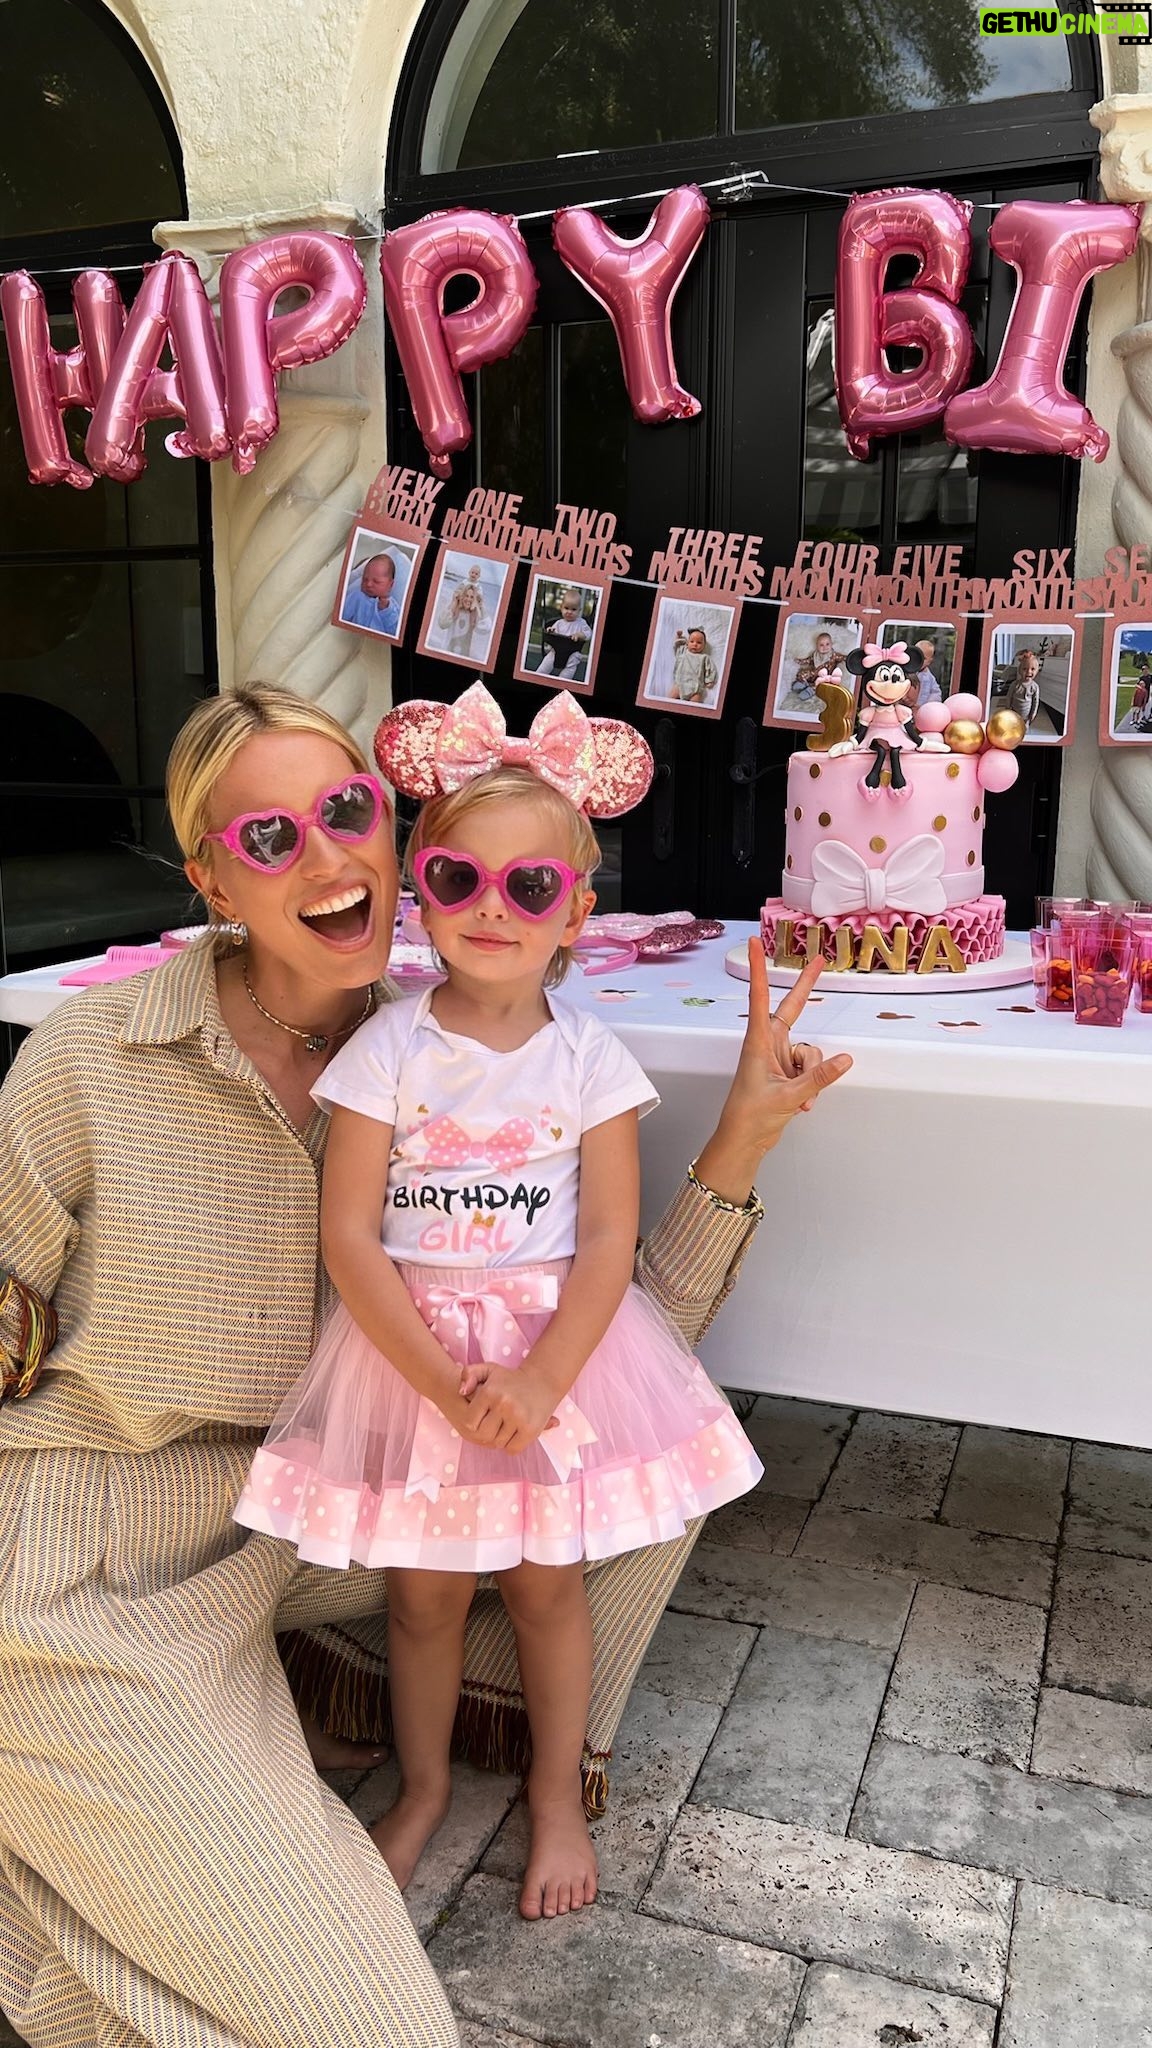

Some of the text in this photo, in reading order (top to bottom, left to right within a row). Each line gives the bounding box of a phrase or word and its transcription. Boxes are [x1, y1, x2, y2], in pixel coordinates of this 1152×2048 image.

[1, 184, 1142, 489] HAPPY BI
[376, 464, 446, 502] NEW
[364, 483, 436, 530] BORN
[464, 487, 524, 523] ONE
[555, 503, 617, 547] TWO
[519, 525, 633, 577] MONTHS
[668, 527, 764, 567] THREE
[793, 541, 880, 576] FOUR
[892, 545, 964, 578] FIVE
[1012, 548, 1072, 579] SIX
[647, 551, 766, 597] MONTHS
[769, 566, 885, 608] MONTH
[806, 682, 854, 752] 3
[774, 919, 967, 974] LUNA
[393, 1183, 551, 1226] BIRTHDAY
[418, 1219, 513, 1254] GIRL
